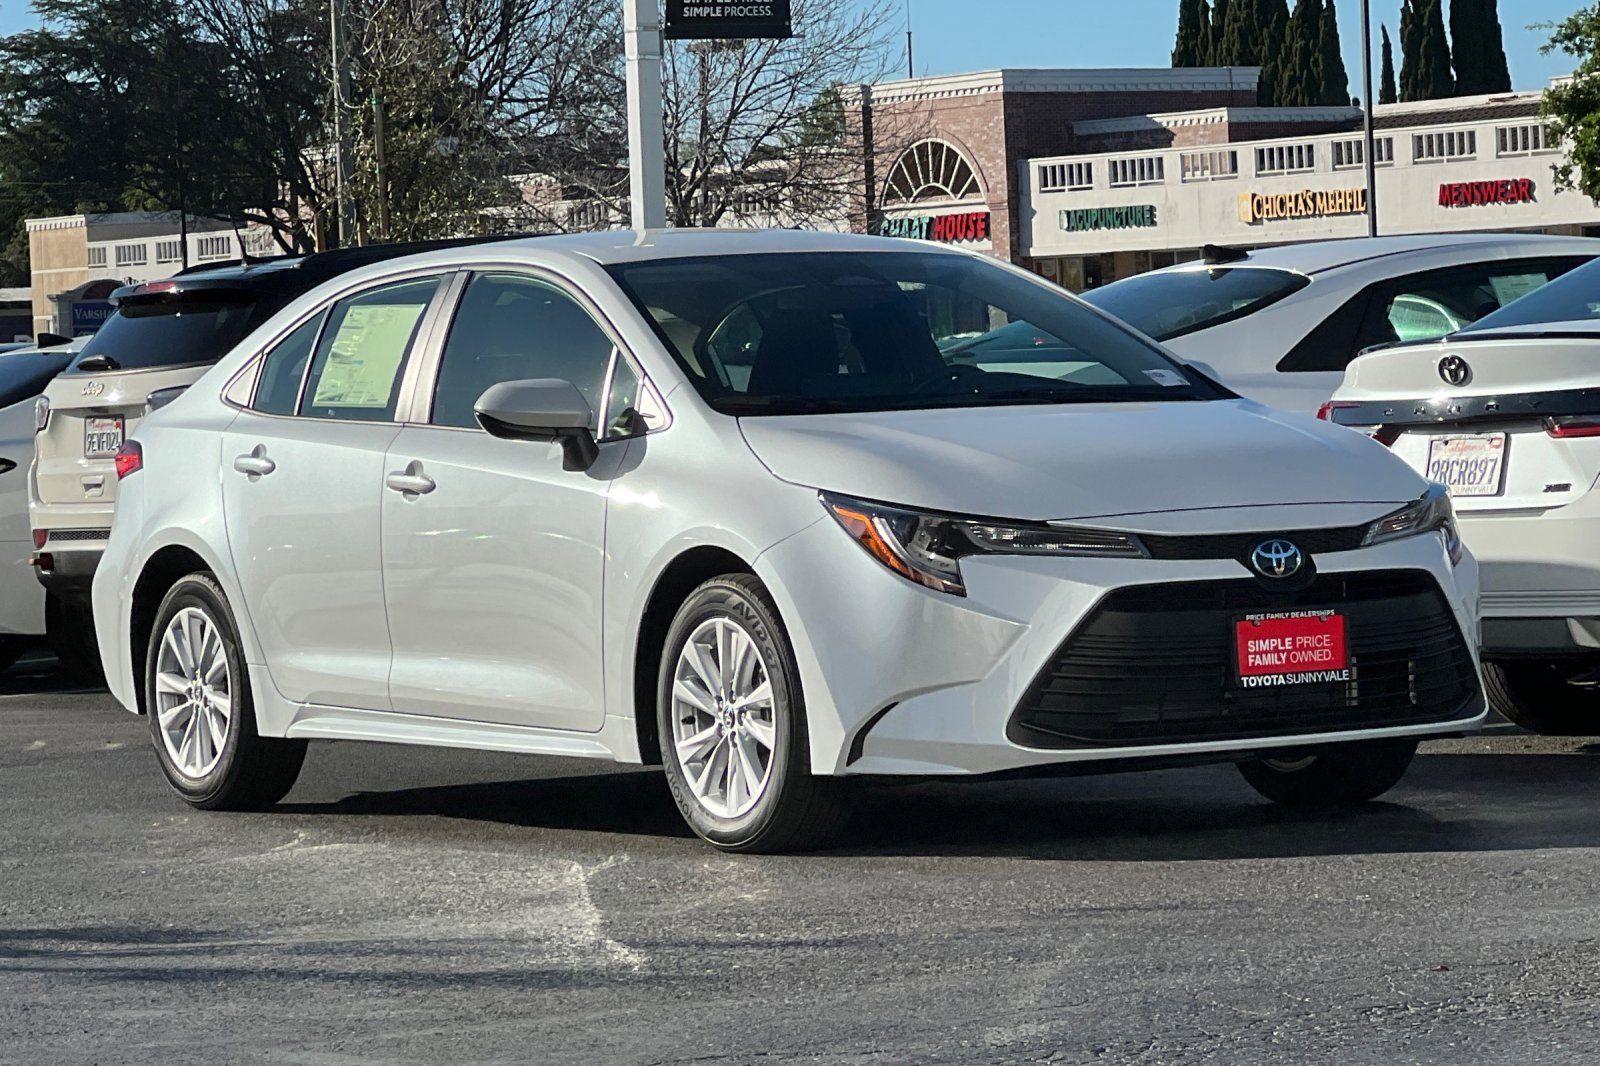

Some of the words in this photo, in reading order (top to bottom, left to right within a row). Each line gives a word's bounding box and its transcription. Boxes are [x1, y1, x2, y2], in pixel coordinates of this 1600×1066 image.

[683, 6, 722, 17] SIMPLE
[724, 6, 774, 17] PROCESS.
[1438, 178, 1530, 208] MENSWEAR
[1252, 190, 1313, 219] CHICHA'S
[1315, 187, 1367, 215] MEHFIL
[933, 211, 986, 241] HOUSE
[1068, 204, 1152, 231] ACUPUNCTURE
[82, 381, 104, 397] Jeep
[1431, 457, 1498, 486] 9RCR897
[1266, 612, 1290, 620] FAMILY
[1291, 609, 1335, 618] DEALERSHIPS
[1248, 637, 1293, 653] SIMPLE
[1296, 634, 1334, 648] PRICE.
[1248, 652, 1288, 667] FAMILY
[1290, 648, 1335, 664] OWNED.
[1241, 674, 1286, 688] TOYOTA
[1286, 669, 1350, 684] SUNNYVALE
